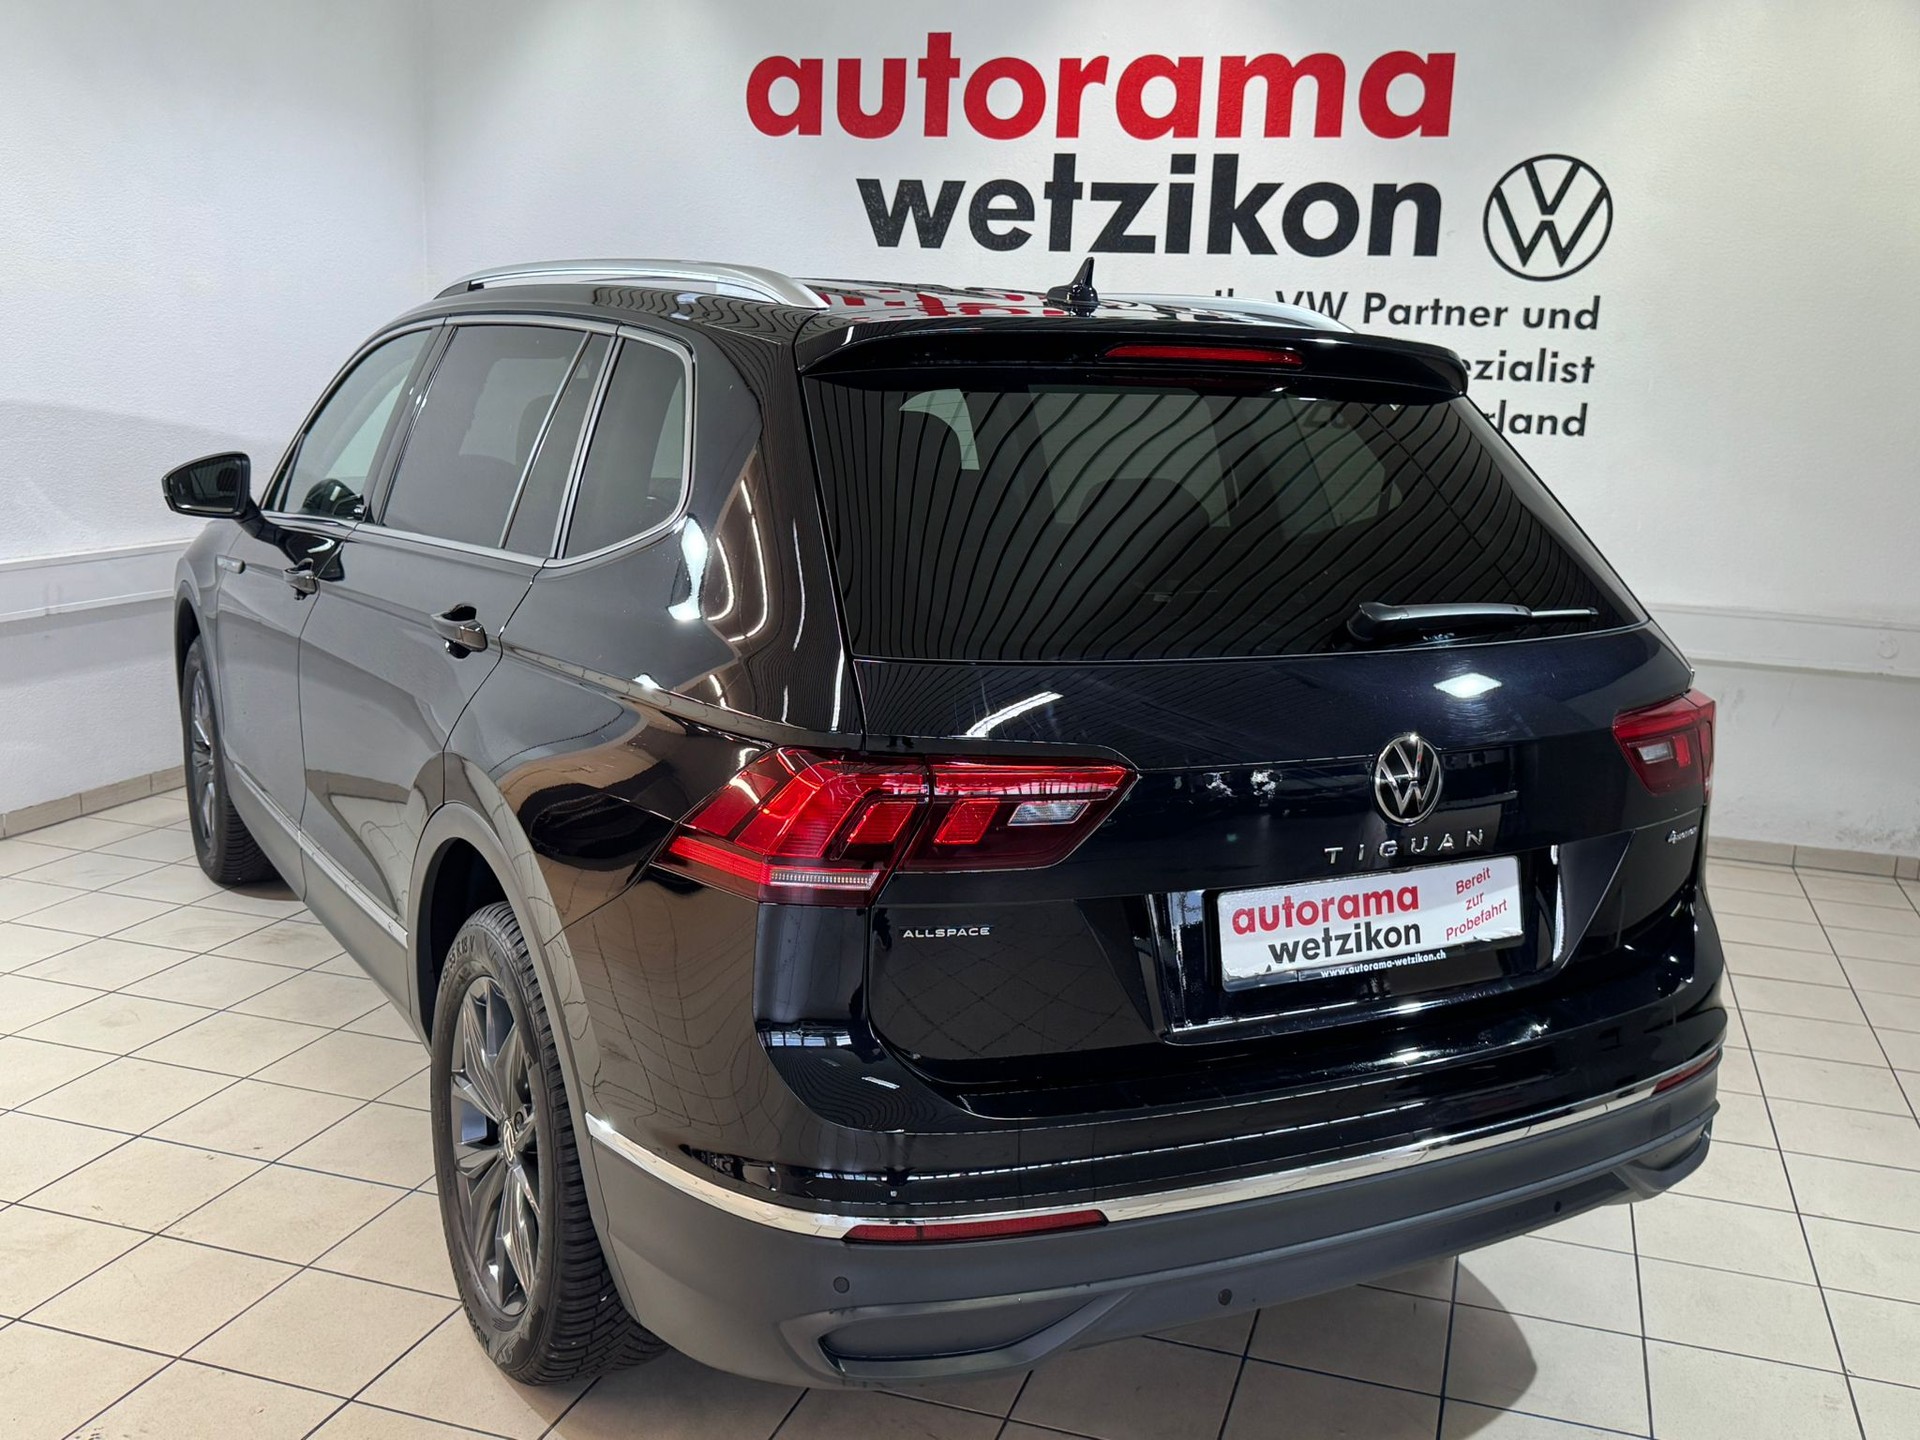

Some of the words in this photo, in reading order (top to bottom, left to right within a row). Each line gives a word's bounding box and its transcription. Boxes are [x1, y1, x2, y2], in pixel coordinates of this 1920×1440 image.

[747, 33, 1456, 140] autorama
[856, 153, 1441, 257] wetzikon
[1483, 154, 1614, 281] VW
[1364, 292, 1508, 328] Partner
[1523, 295, 1601, 330] und
[1373, 732, 1443, 827] VW
[1324, 828, 1484, 864] TIGUAN
[1456, 867, 1491, 895] Bereit
[1465, 892, 1484, 910] zur
[1232, 885, 1419, 936] autorama
[1446, 899, 1507, 941] Probefahrt
[903, 927, 990, 938] ALLSPACE
[1268, 921, 1421, 964] wetzikon
[1320, 949, 1447, 978] www.autorama-wetzikon.ch
